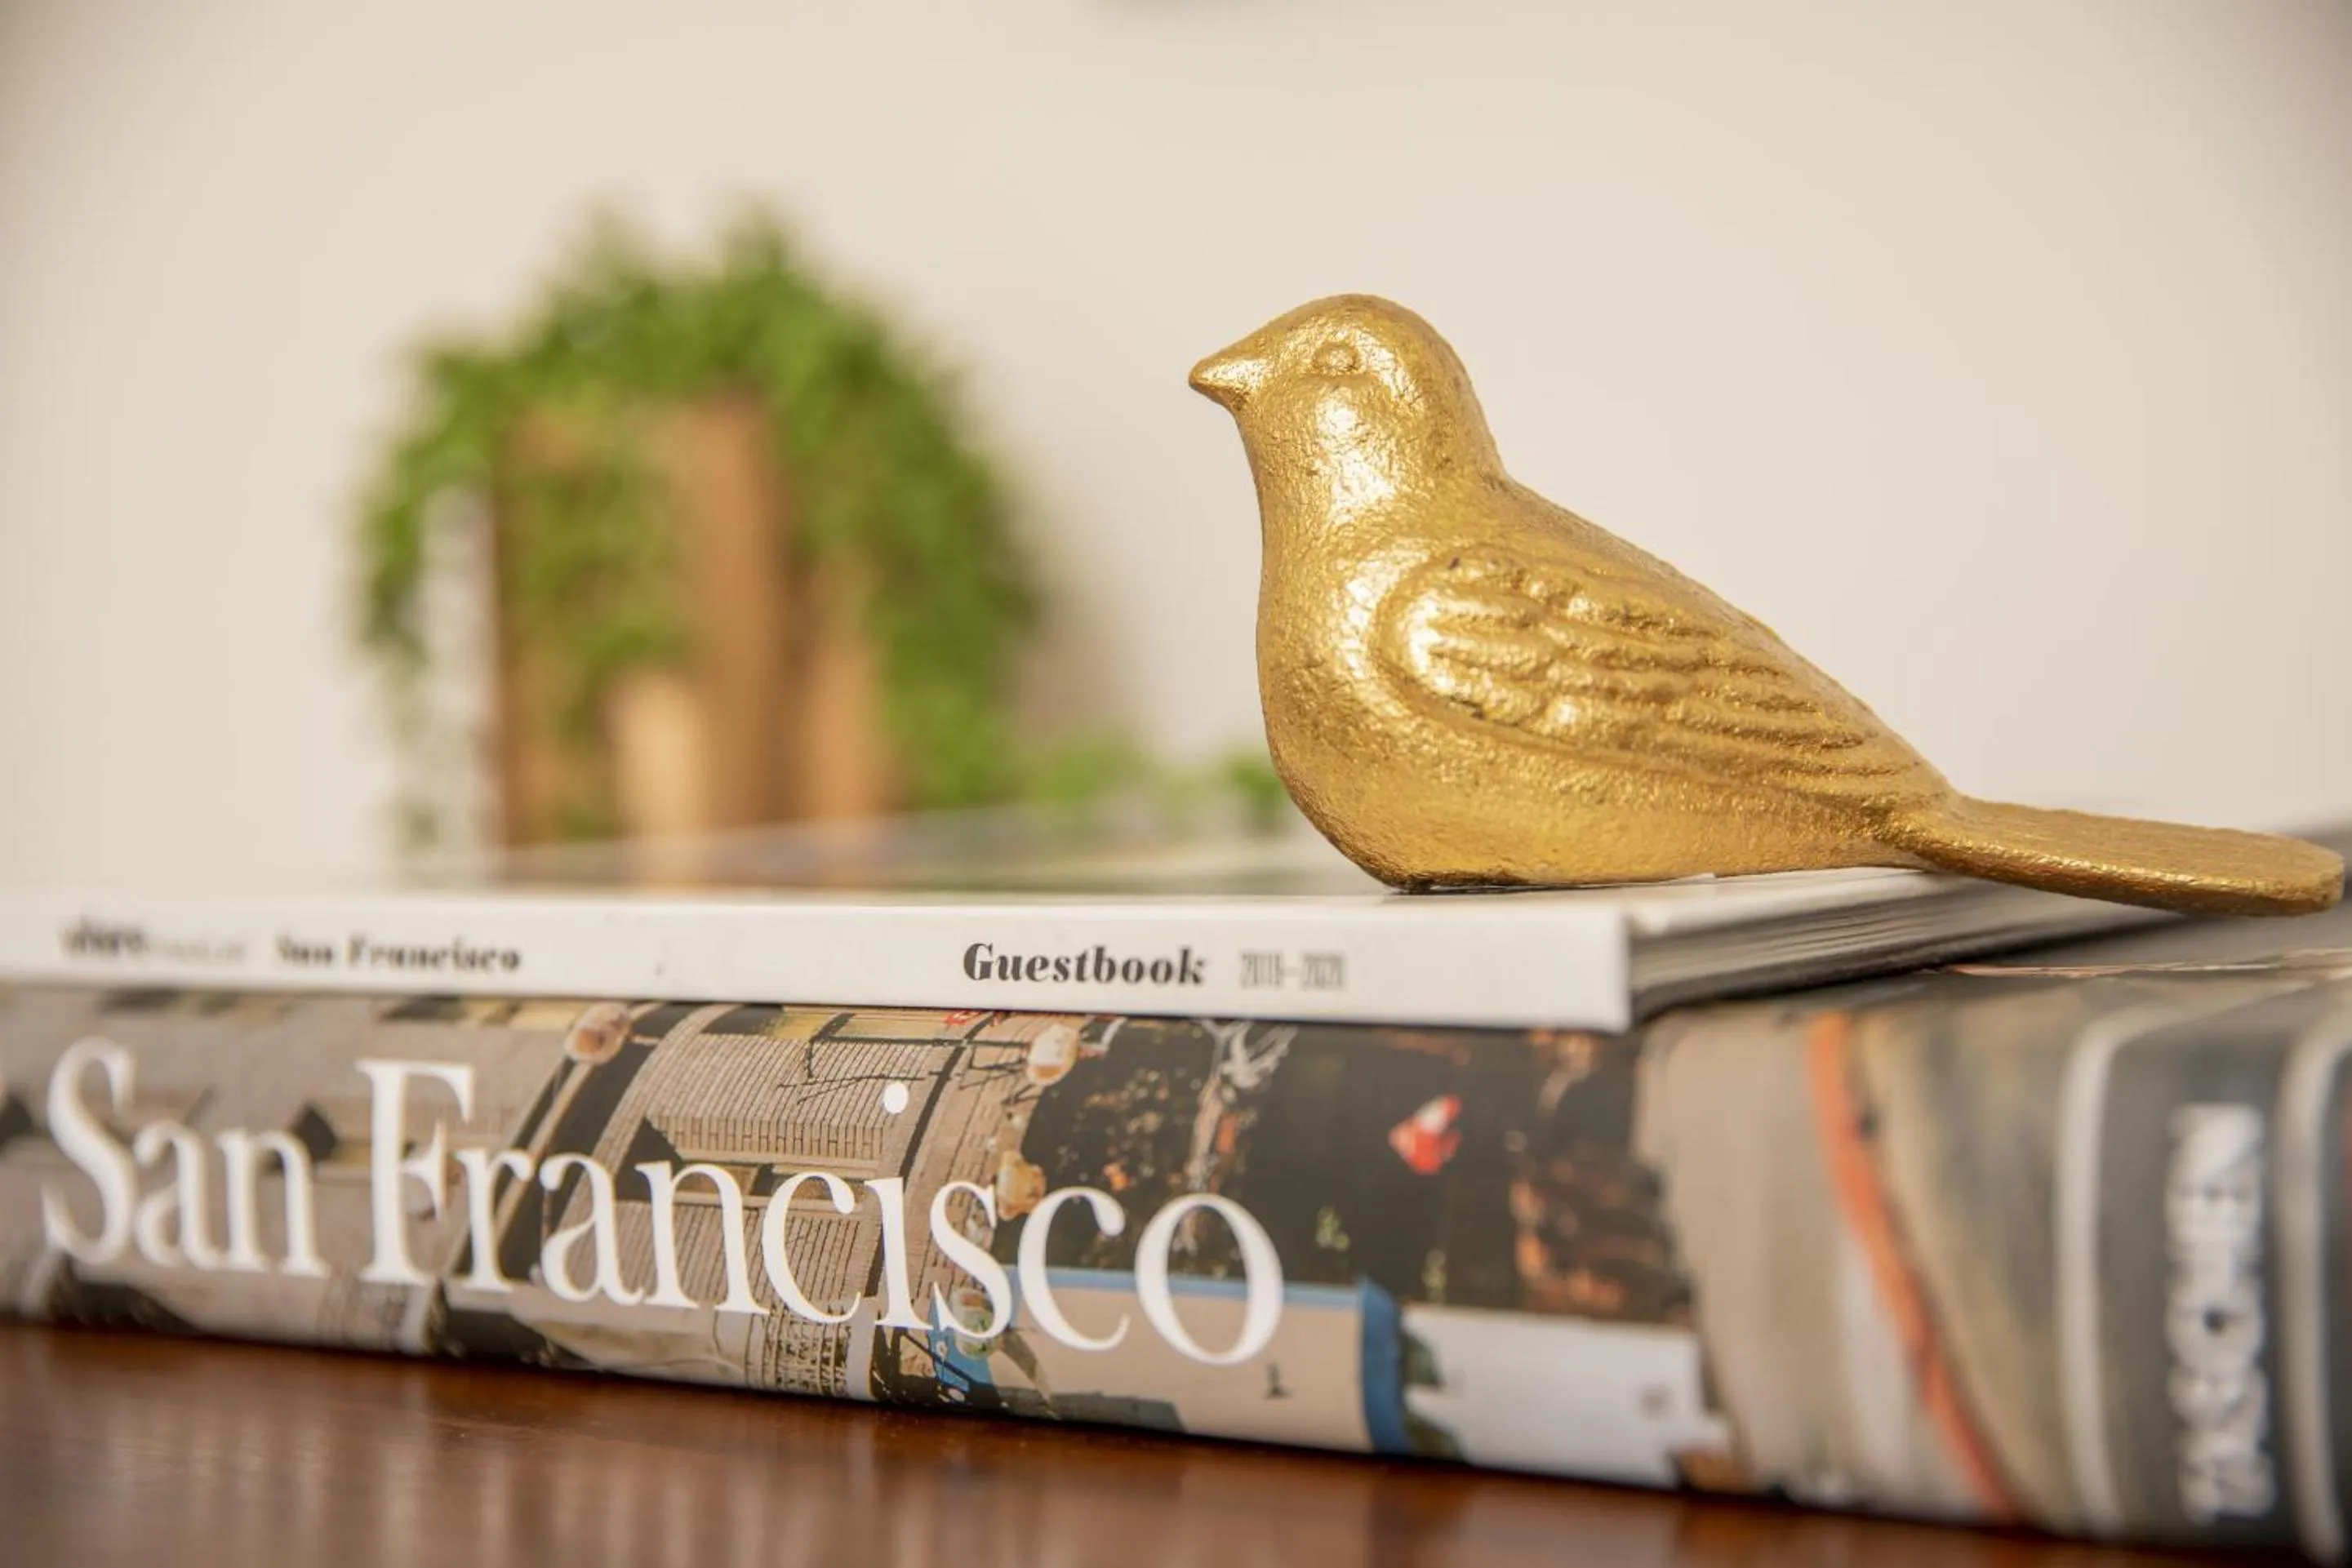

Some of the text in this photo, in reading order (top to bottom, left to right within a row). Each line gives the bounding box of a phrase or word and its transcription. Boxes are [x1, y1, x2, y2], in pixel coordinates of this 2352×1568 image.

[274, 931, 333, 967] San
[347, 933, 522, 972] Francisco
[963, 941, 1207, 987] Guestbook
[41, 1035, 1284, 1366] San Francisco
